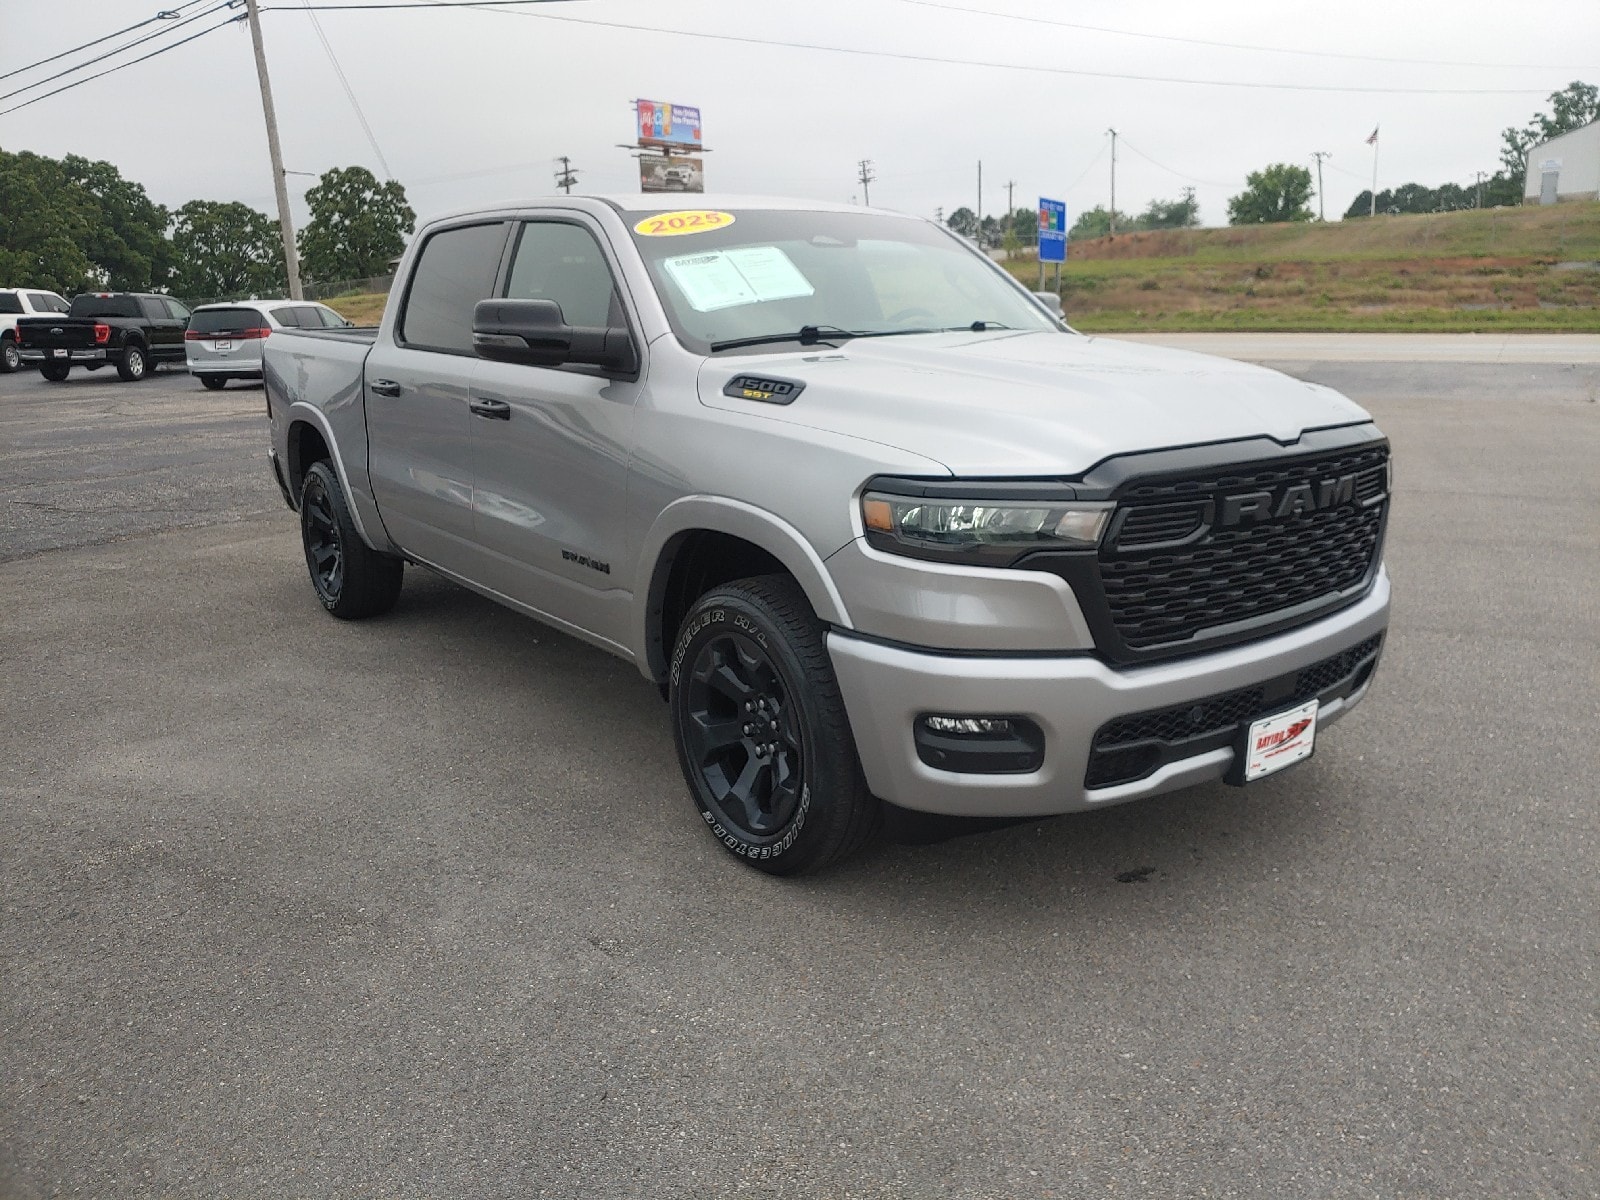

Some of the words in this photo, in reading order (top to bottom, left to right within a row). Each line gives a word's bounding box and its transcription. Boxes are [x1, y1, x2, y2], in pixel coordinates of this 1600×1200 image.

[650, 212, 722, 233] 2025
[736, 377, 794, 394] 1500
[1223, 474, 1355, 525] RAM
[672, 609, 725, 686] DUELER
[702, 782, 811, 860] BRIDGESTONE
